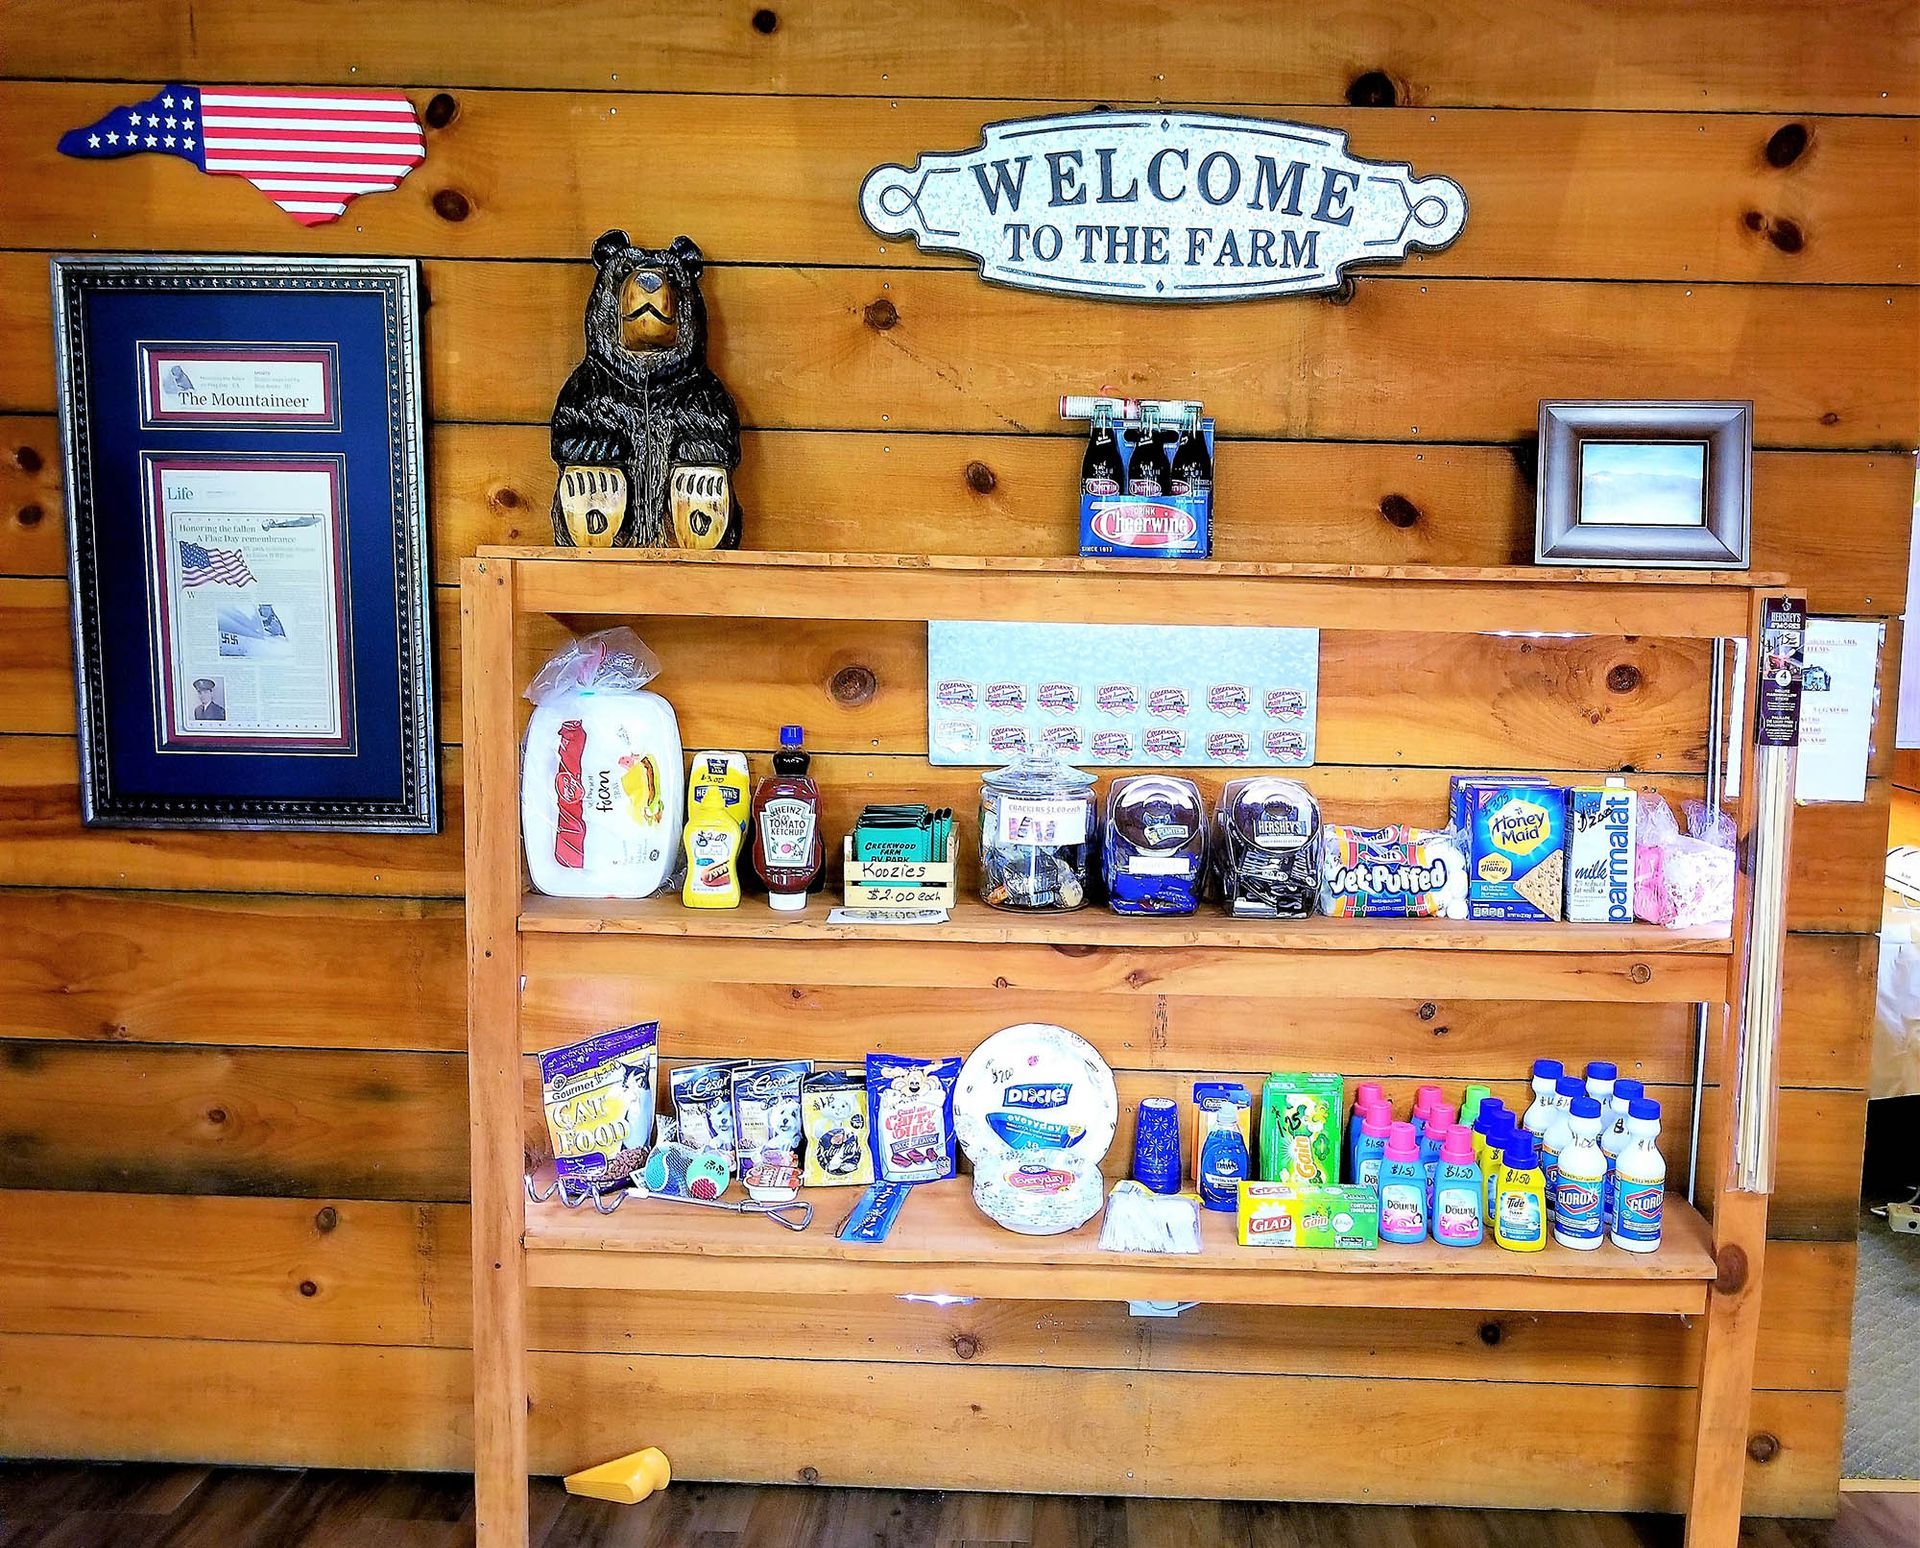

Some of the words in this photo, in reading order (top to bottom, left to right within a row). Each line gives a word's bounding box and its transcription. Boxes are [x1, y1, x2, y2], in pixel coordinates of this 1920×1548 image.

[968, 147, 1361, 227] WELCOME
[1003, 223, 1063, 262] TO
[1075, 224, 1171, 266] THE
[1184, 227, 1321, 269] FARM
[178, 391, 208, 406] The
[212, 392, 309, 408] Mountaineer
[167, 486, 194, 501] Life
[1100, 508, 1188, 539] Cheerwine
[774, 805, 802, 816] HEINZ
[769, 819, 807, 830] TOMATO
[770, 828, 805, 836] KETCHUP
[1258, 820, 1302, 834] HERSHEY'S
[1491, 812, 1545, 838] Honey
[1501, 827, 1540, 845] Maid
[865, 842, 917, 851] CREEKWOOD
[1604, 796, 1632, 922] parmalat
[1575, 859, 1608, 880] milk
[867, 888, 915, 902] $2.00
[551, 1080, 596, 1101] Gourmet
[692, 1073, 731, 1096] Cesar
[553, 1096, 606, 1130] CAT
[556, 1121, 631, 1154] FOOD
[1295, 1137, 1316, 1179] Gain
[1387, 1199, 1418, 1213] Downy
[1507, 1197, 1525, 1209] Tide
[1557, 1192, 1594, 1205] CLOROX
[1445, 1204, 1476, 1218] Downy
[1252, 1216, 1291, 1232] GLAD
[1302, 1215, 1328, 1230] Gain
